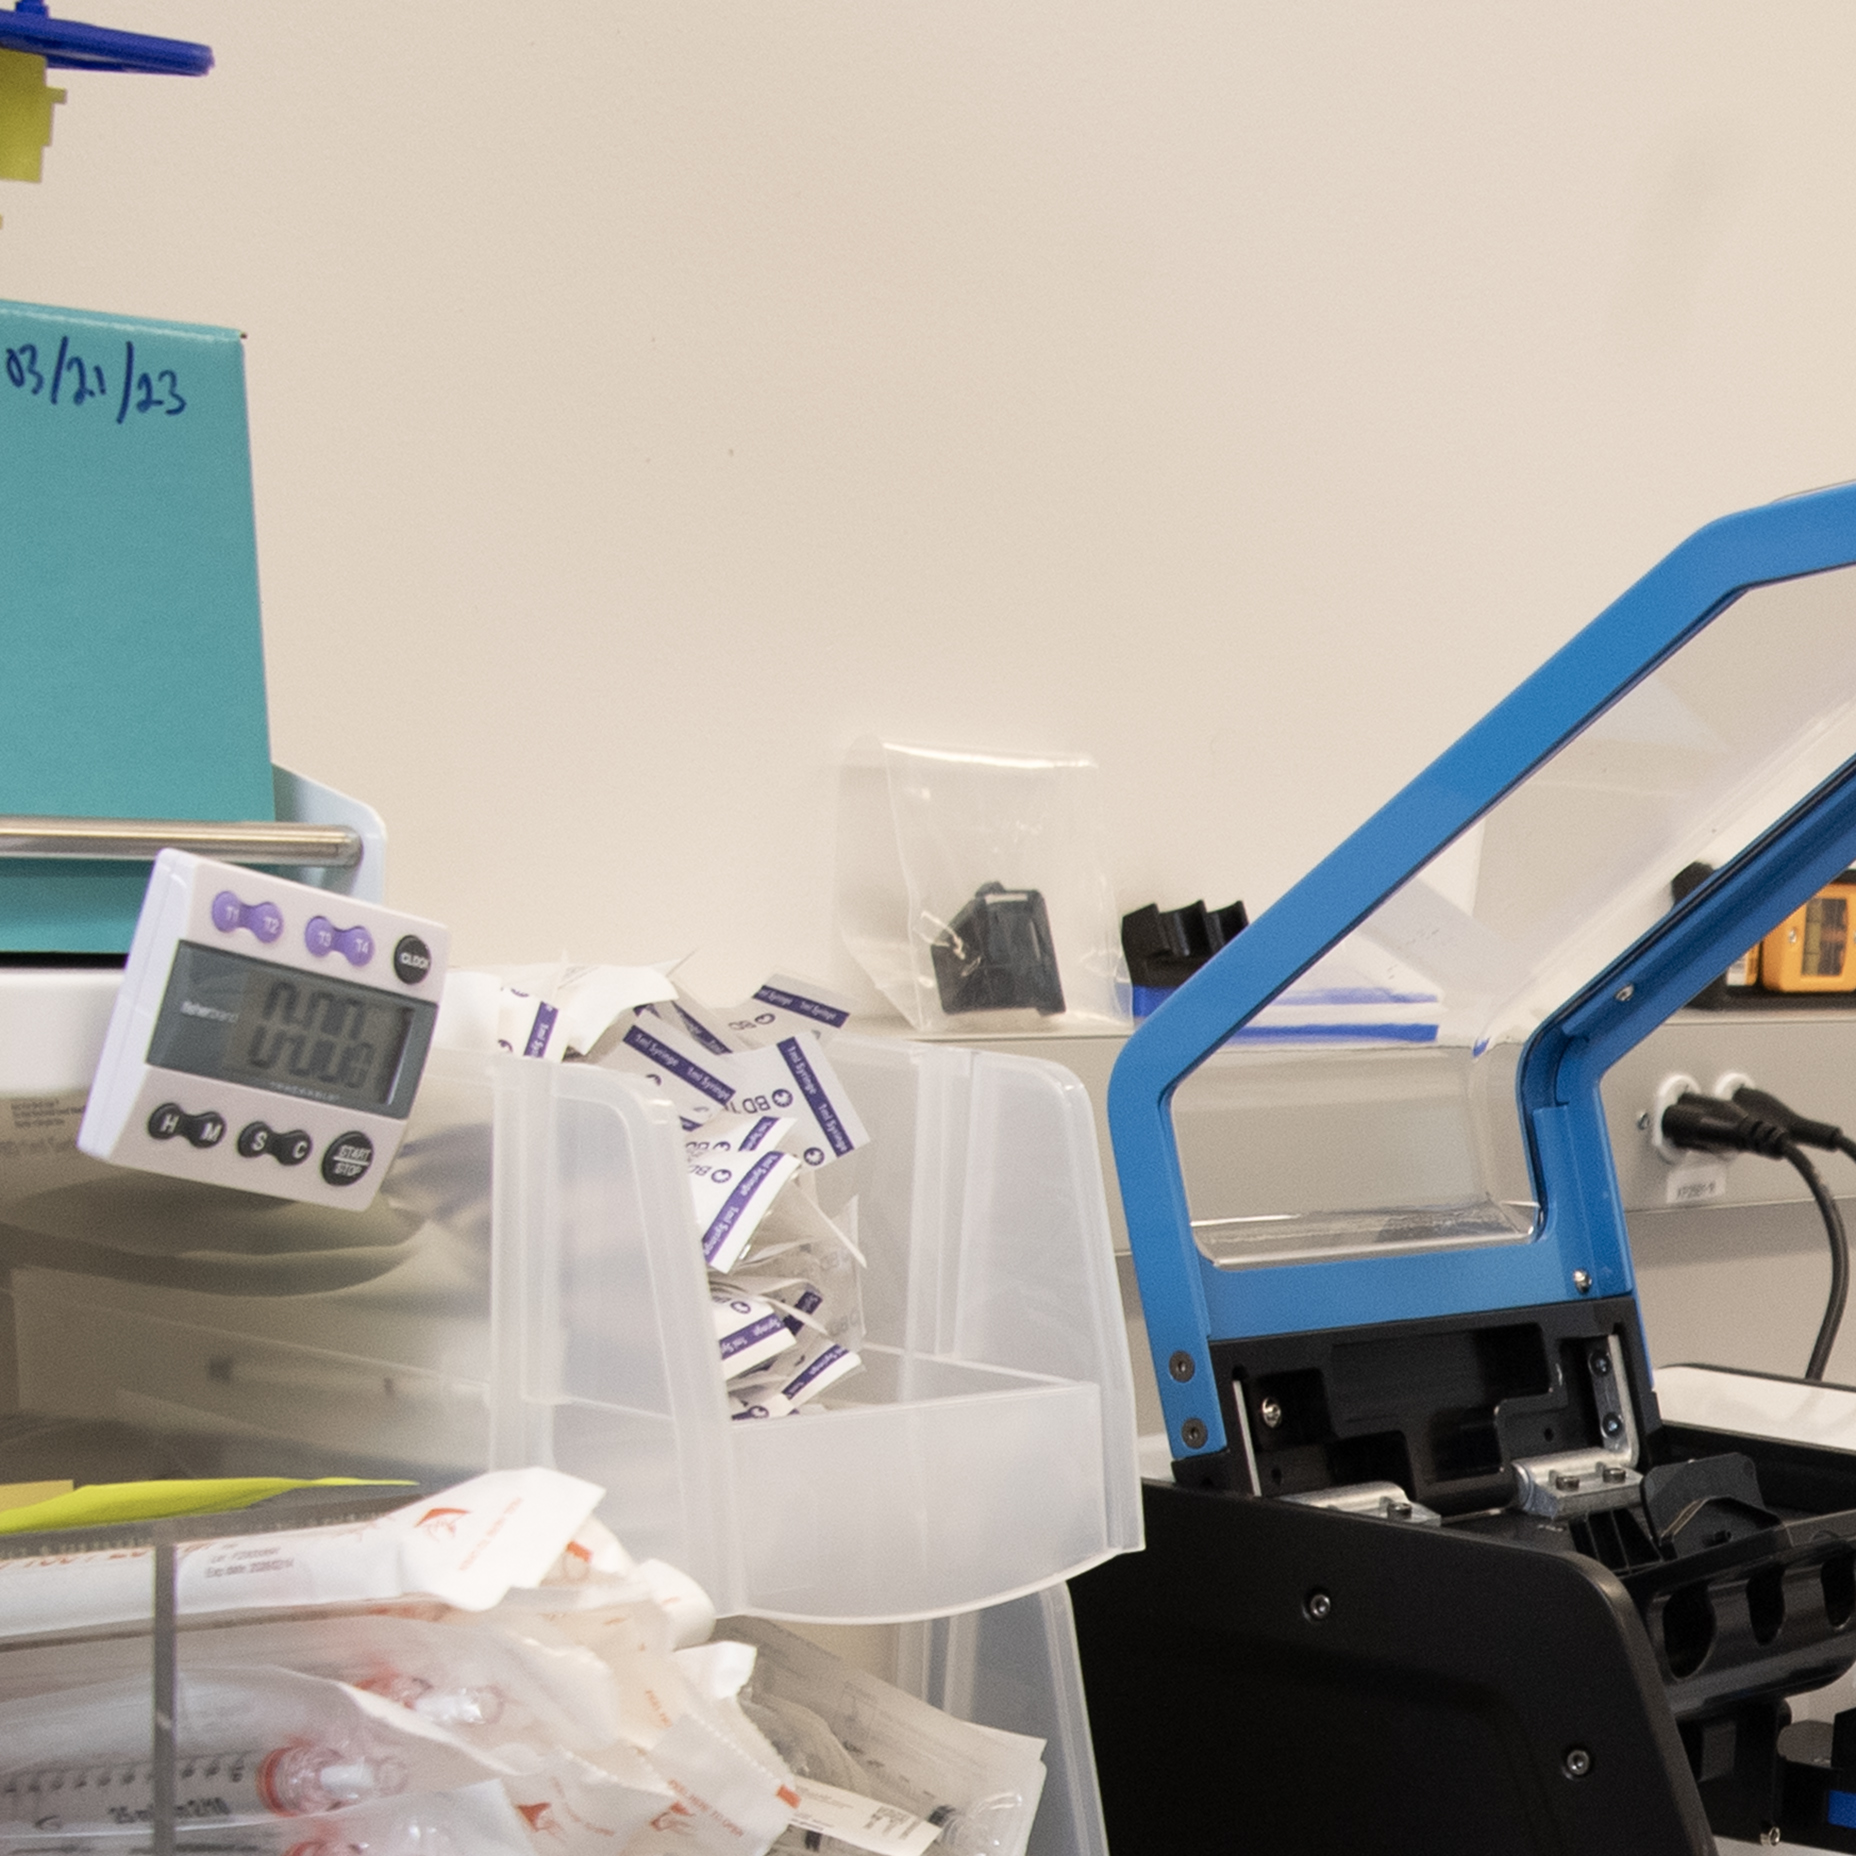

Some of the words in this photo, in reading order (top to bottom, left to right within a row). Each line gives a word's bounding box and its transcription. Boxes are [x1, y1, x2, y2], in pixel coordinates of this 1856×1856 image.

[226, 905, 241, 922] T1
[263, 914, 280, 935] T2
[354, 938, 371, 955] T4
[647, 1042, 681, 1069] Syringe
[699, 1076, 731, 1103] Syringe
[742, 1094, 771, 1114] BD
[795, 1060, 818, 1096] Syringe
[826, 1116, 849, 1153] Syringe
[160, 1113, 179, 1133] H
[201, 1122, 223, 1143] M
[251, 1130, 269, 1152] S
[292, 1139, 309, 1160] C
[338, 1143, 373, 1161] START
[333, 1160, 364, 1177] STOP
[739, 1166, 767, 1197] Syringe
